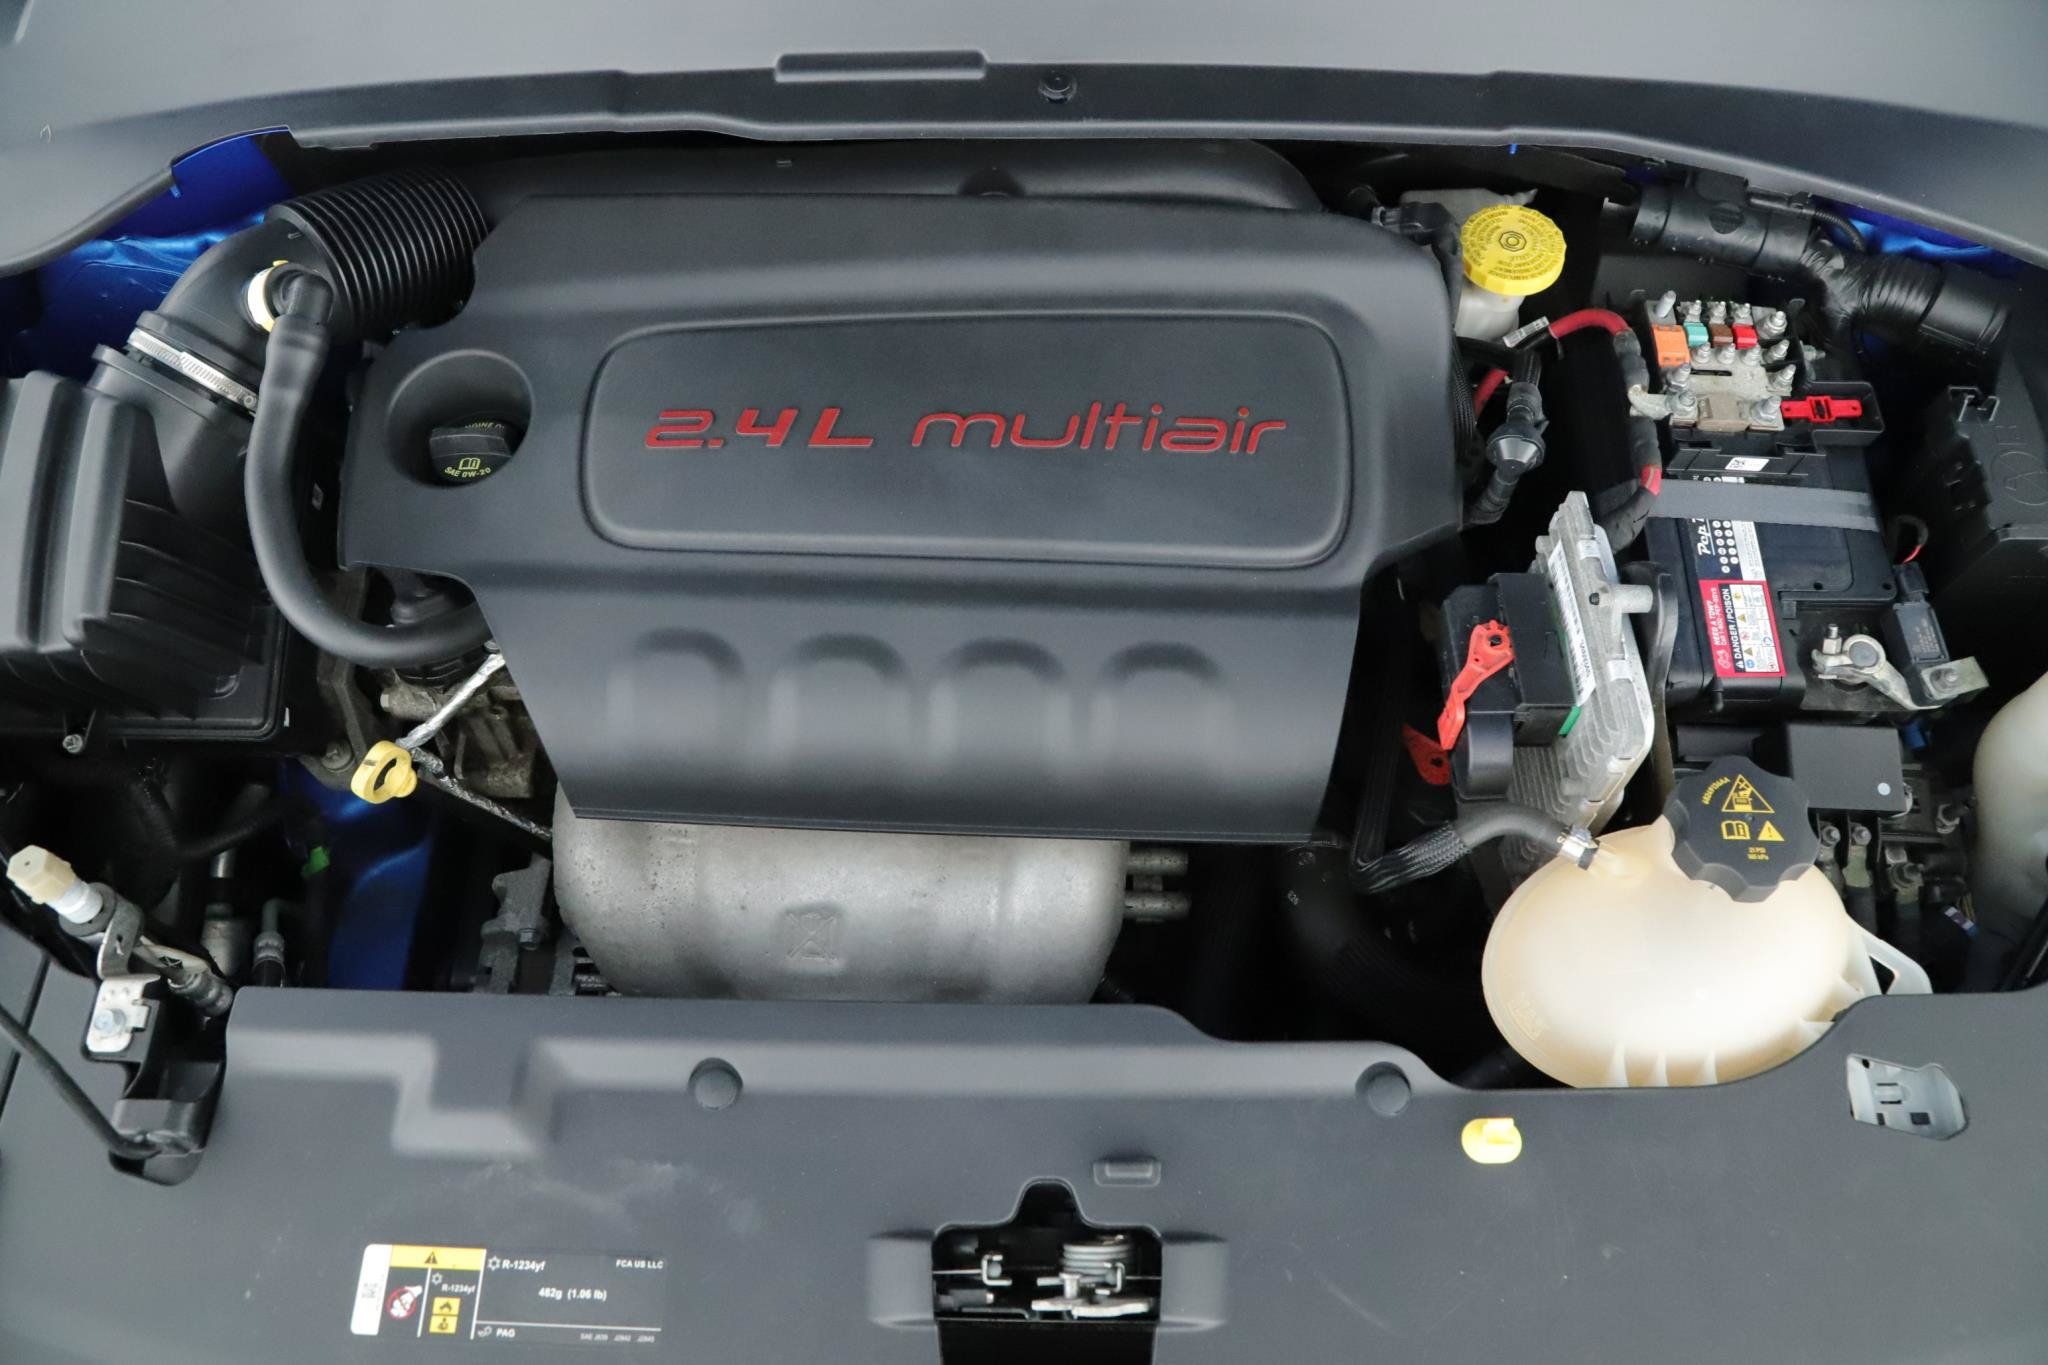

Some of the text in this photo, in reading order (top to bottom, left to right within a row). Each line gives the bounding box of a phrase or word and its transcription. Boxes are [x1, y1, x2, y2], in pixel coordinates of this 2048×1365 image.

[911, 402, 1288, 454] multiair
[444, 466, 492, 478] SAE 0W-20
[1722, 588, 1736, 619] POISON
[1728, 624, 1743, 659] DANGER
[502, 1259, 664, 1271] R-1234yf FCA US LLC
